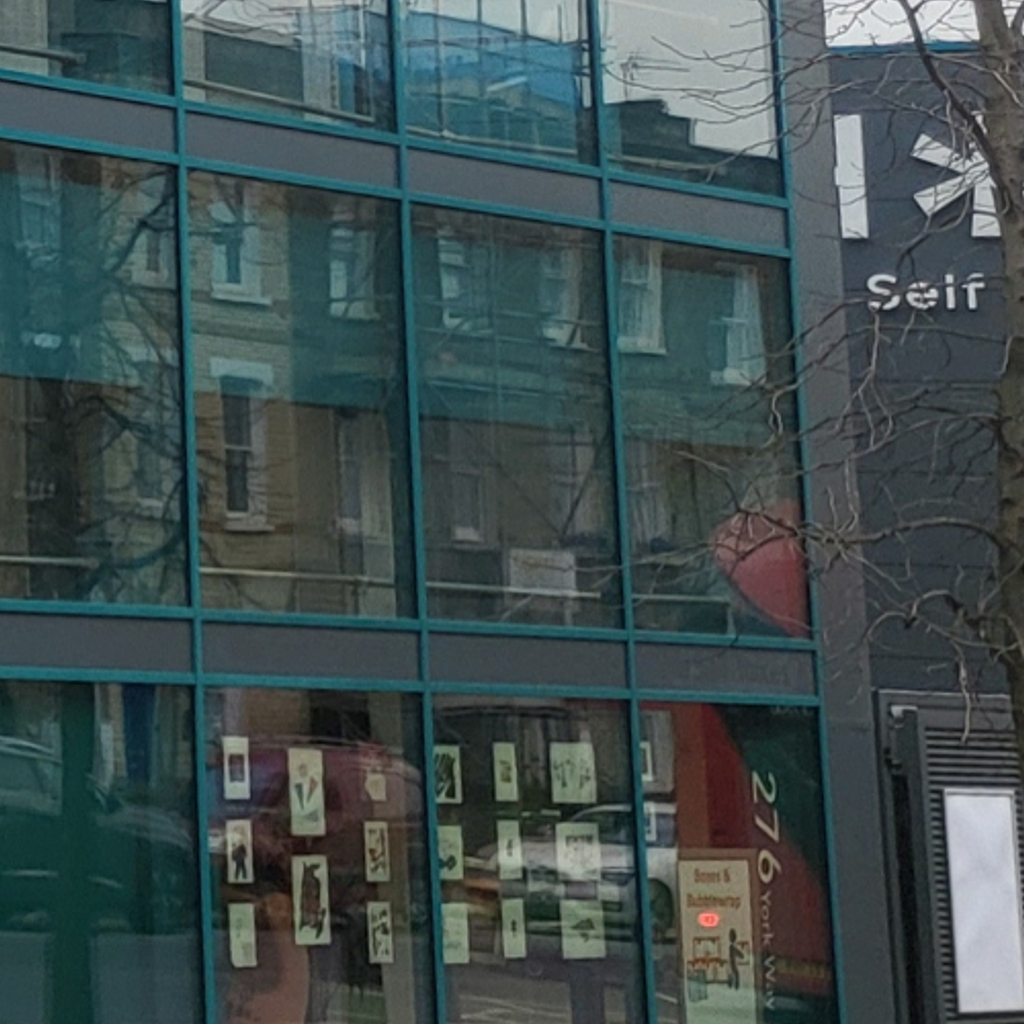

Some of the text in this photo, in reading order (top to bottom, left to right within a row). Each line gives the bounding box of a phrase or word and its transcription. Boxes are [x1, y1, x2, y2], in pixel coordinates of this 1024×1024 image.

[867, 273, 986, 310] Self
[752, 771, 781, 883] 276
[760, 891, 774, 945] York
